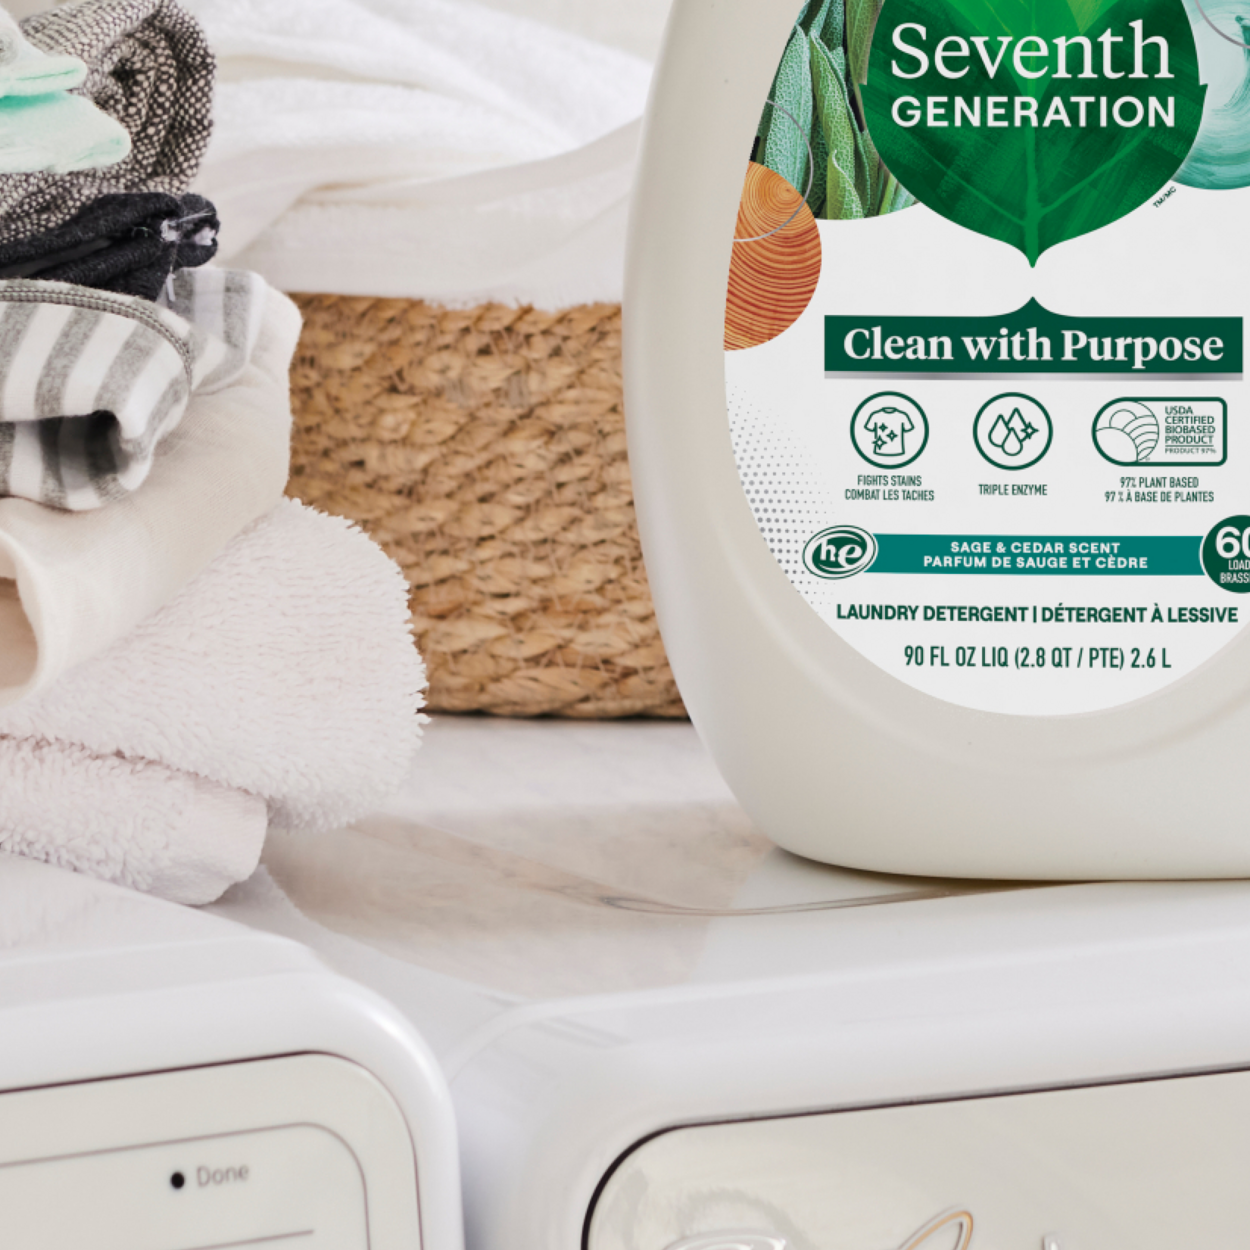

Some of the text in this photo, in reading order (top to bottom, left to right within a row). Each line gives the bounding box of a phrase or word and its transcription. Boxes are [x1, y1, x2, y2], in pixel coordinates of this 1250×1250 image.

[890, 19, 1175, 79] Seventh
[891, 96, 1175, 128] GENERATION
[843, 326, 1224, 369] Clean with Purpose
[1165, 406, 1194, 415] USDA
[1165, 416, 1215, 425] CERTIFIED
[1165, 425, 1216, 434] BIOBASED
[1165, 435, 1213, 444] PRODUCT
[857, 475, 922, 487] FIGHTS STAINS
[1120, 476, 1199, 488] 97% PLANT BASED
[845, 489, 934, 501] COMBAT LES TACHES
[978, 484, 1048, 496] TRIPLE ENZYME
[1104, 491, 1116, 502] 97
[1126, 489, 1133, 502] À
[1135, 491, 1158, 502] BASE
[1160, 491, 1172, 502] DE
[1174, 491, 1214, 502] PLANTES
[820, 538, 863, 567] he
[950, 542, 1120, 554] SAGE & CEDAR SCENT
[923, 554, 1148, 569] PARFUM DE SAUGE ET CÈDRE
[836, 604, 919, 620] LAUNDRY
[923, 606, 1029, 622] DETERGENT
[1041, 603, 1147, 623] DÉTERGENT
[1151, 603, 1164, 623] À
[1168, 607, 1239, 623] LESSIVE
[904, 646, 924, 666] 90
[930, 646, 950, 666] FL
[956, 646, 976, 666] OZ
[981, 646, 1009, 667] LIQ
[1014, 646, 1046, 670] (2.8
[1051, 647, 1073, 668] QT
[1089, 647, 1125, 670] PTE)
[1130, 647, 1156, 668] 2.6
[1162, 648, 1172, 668] L
[196, 1164, 249, 1187] Done
